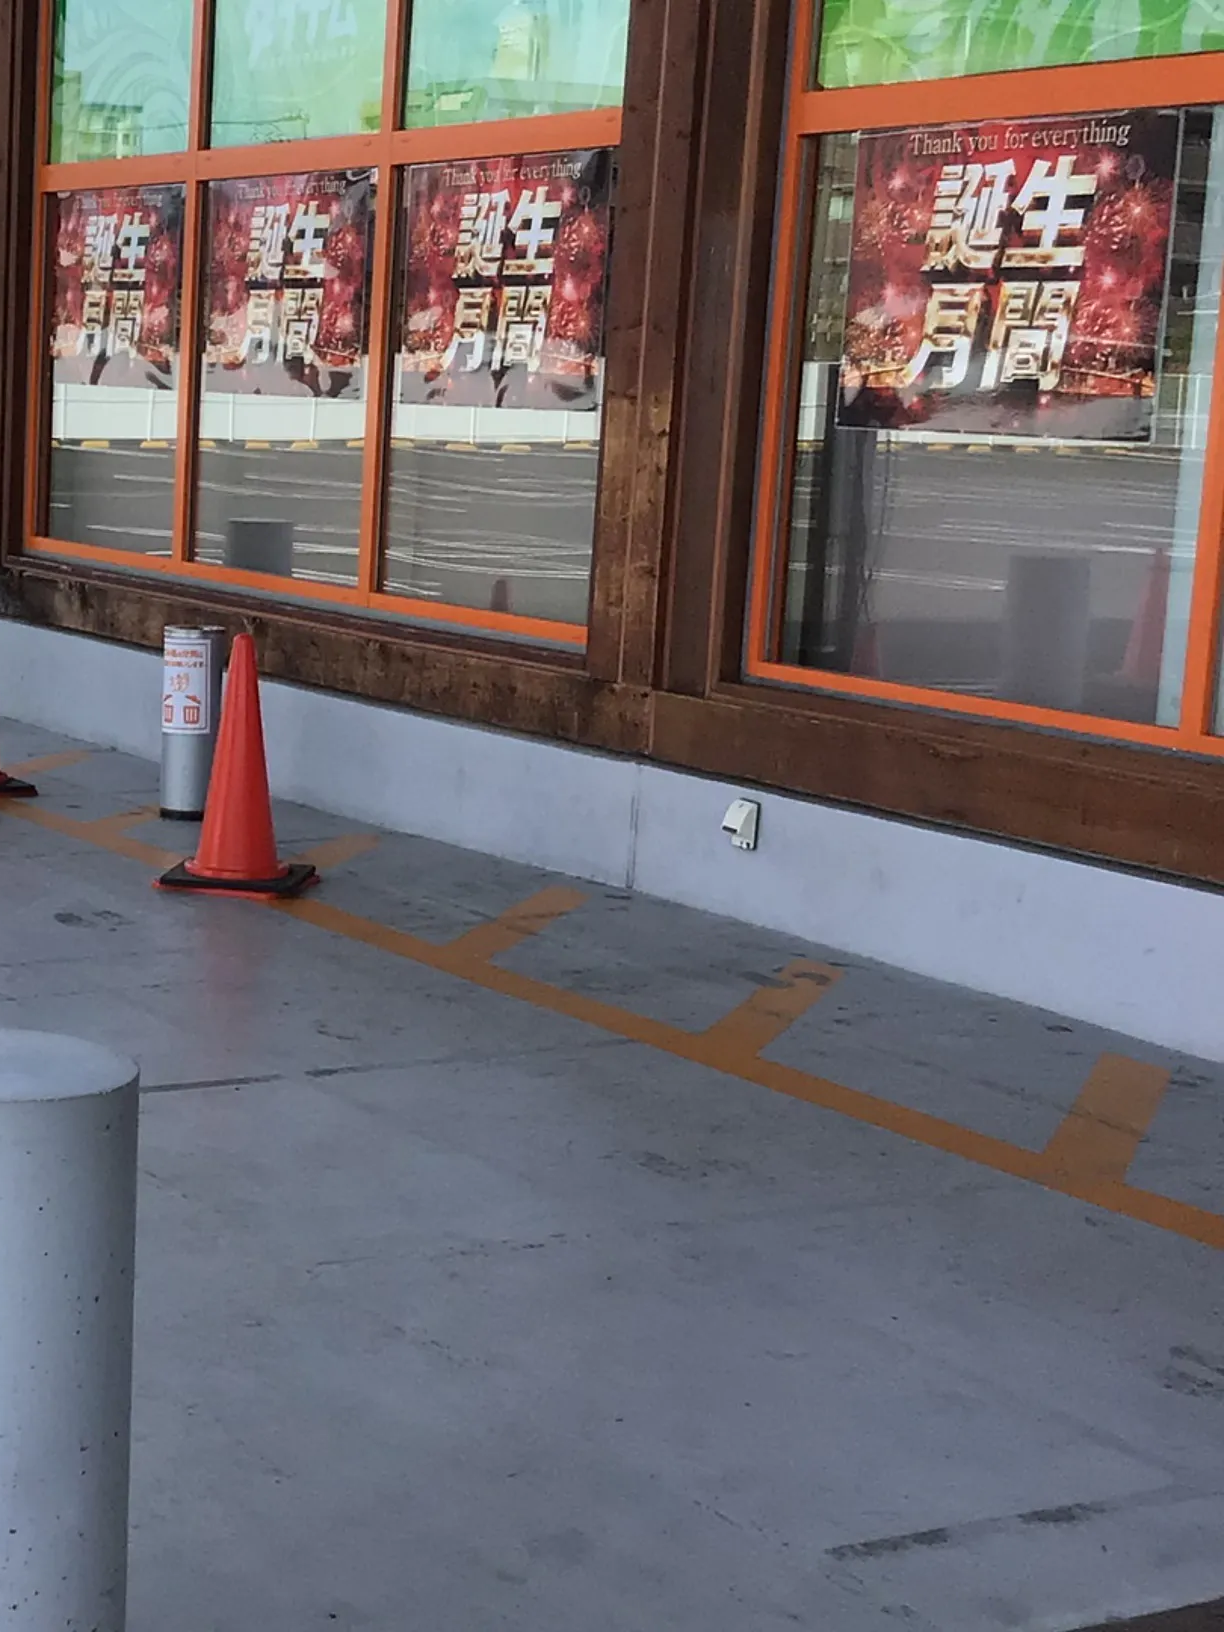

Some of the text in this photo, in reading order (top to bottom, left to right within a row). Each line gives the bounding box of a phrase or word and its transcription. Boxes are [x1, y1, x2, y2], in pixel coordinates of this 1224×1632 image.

[910, 120, 1131, 155] Thank you for everything
[81, 212, 150, 283] 誕生
[245, 201, 330, 281] 誕生
[452, 186, 562, 279] 誕生
[920, 155, 1098, 271] 誕生
